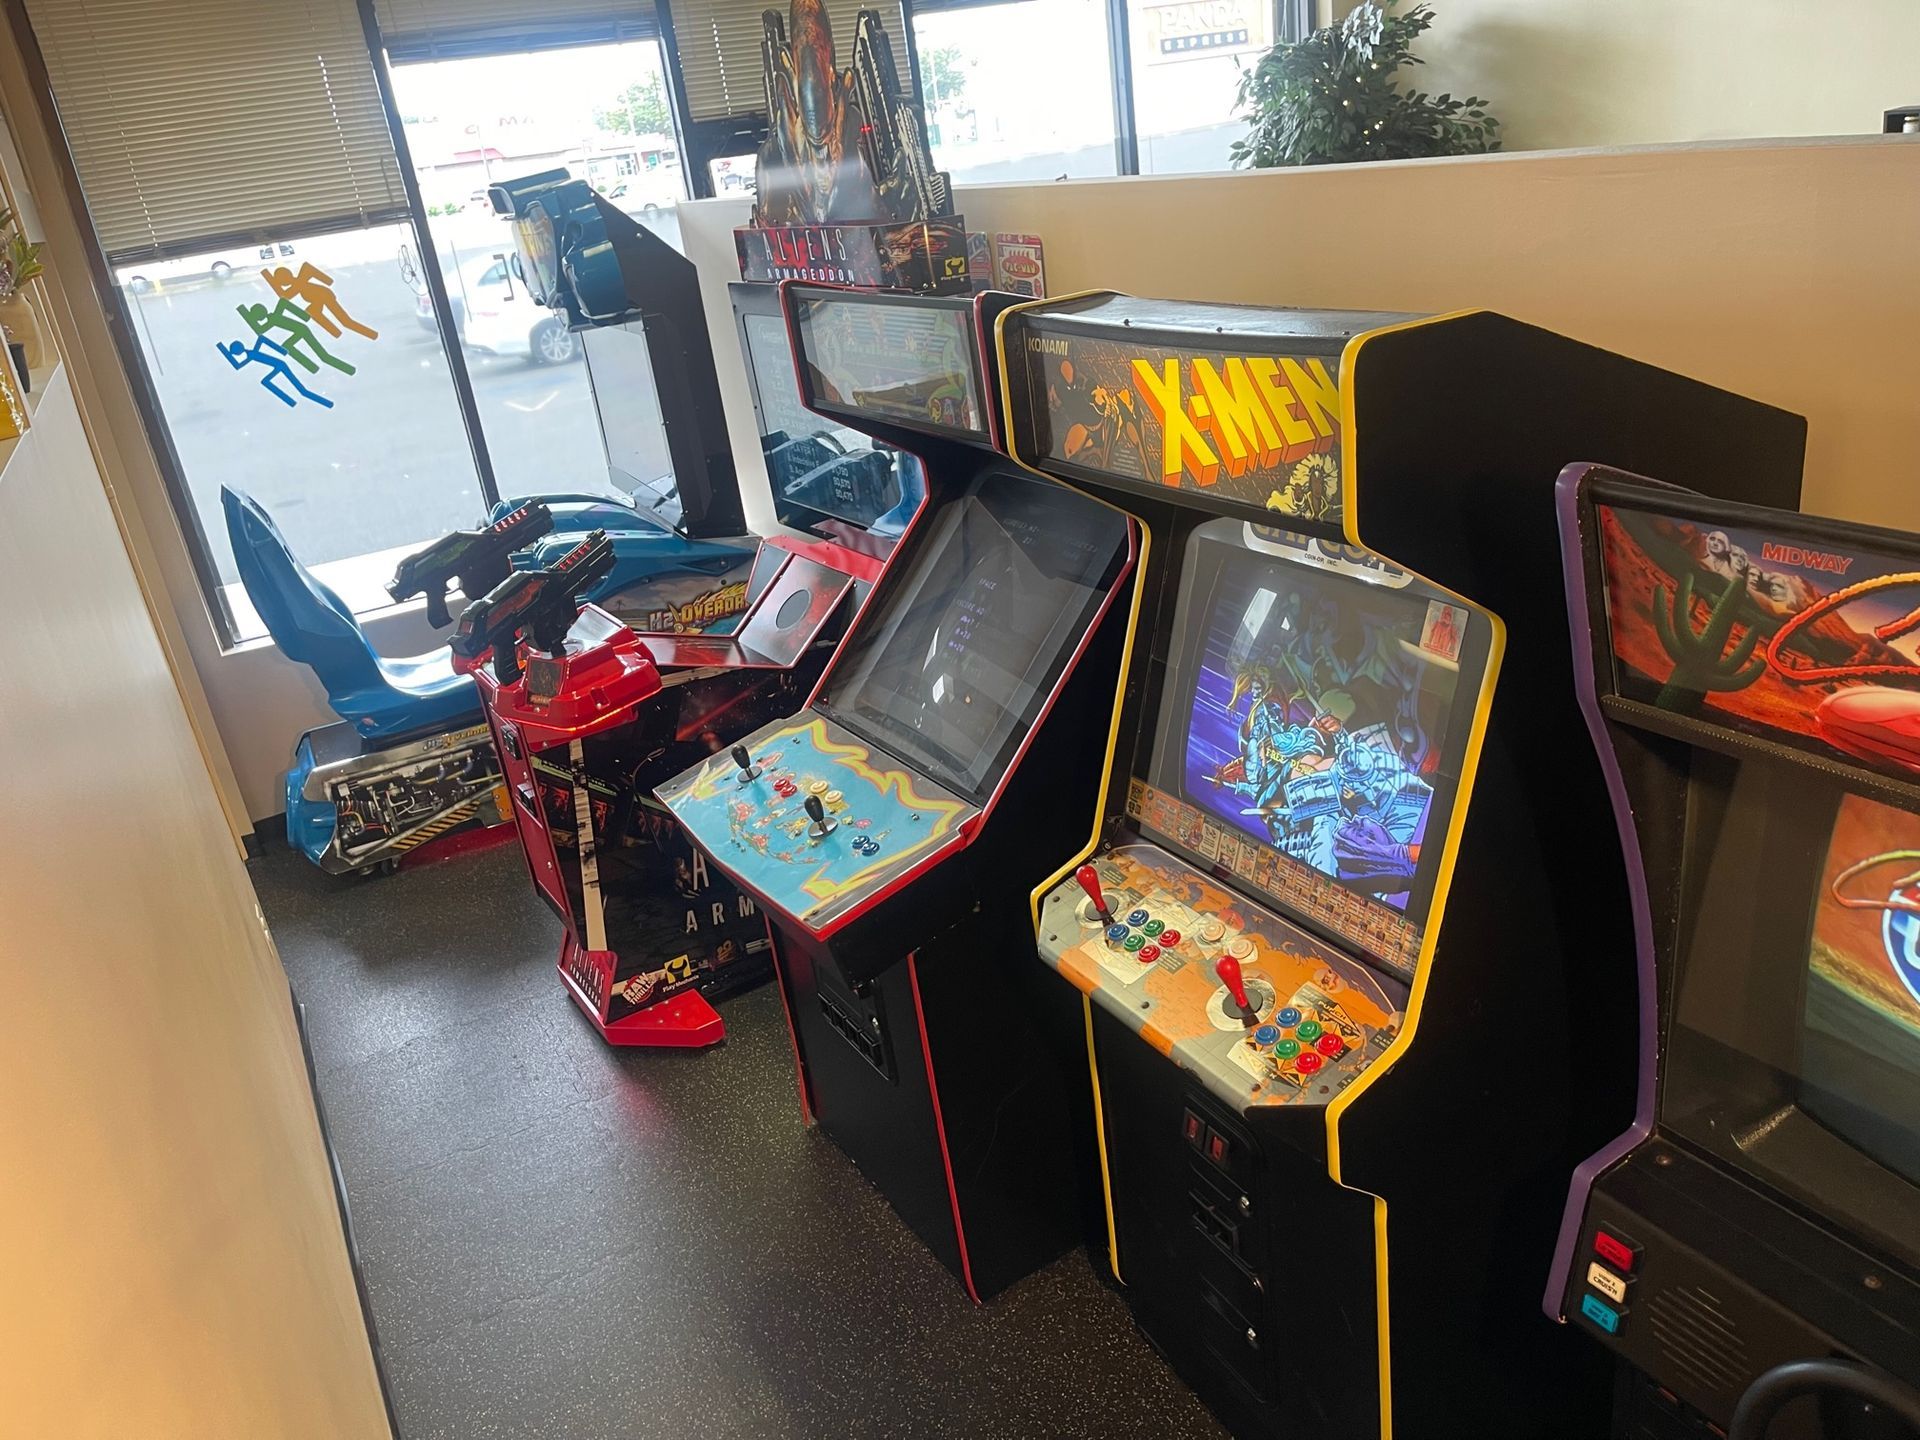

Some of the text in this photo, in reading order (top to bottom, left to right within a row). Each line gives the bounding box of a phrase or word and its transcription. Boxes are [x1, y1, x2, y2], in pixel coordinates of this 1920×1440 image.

[1158, 0, 1248, 35] PANDA
[1162, 30, 1247, 52] EXPRESS
[762, 228, 847, 261] ALIENS
[767, 267, 855, 281] ARMAGEDDON
[1027, 336, 1069, 356] KONAMI
[1131, 356, 1340, 488] X-MEN
[1761, 542, 1854, 575] MIDWAY
[1265, 747, 1287, 762] FREE
[686, 895, 755, 933] ARM
[622, 972, 650, 1002] RAW
[1317, 1000, 1348, 1021] PUNCH
